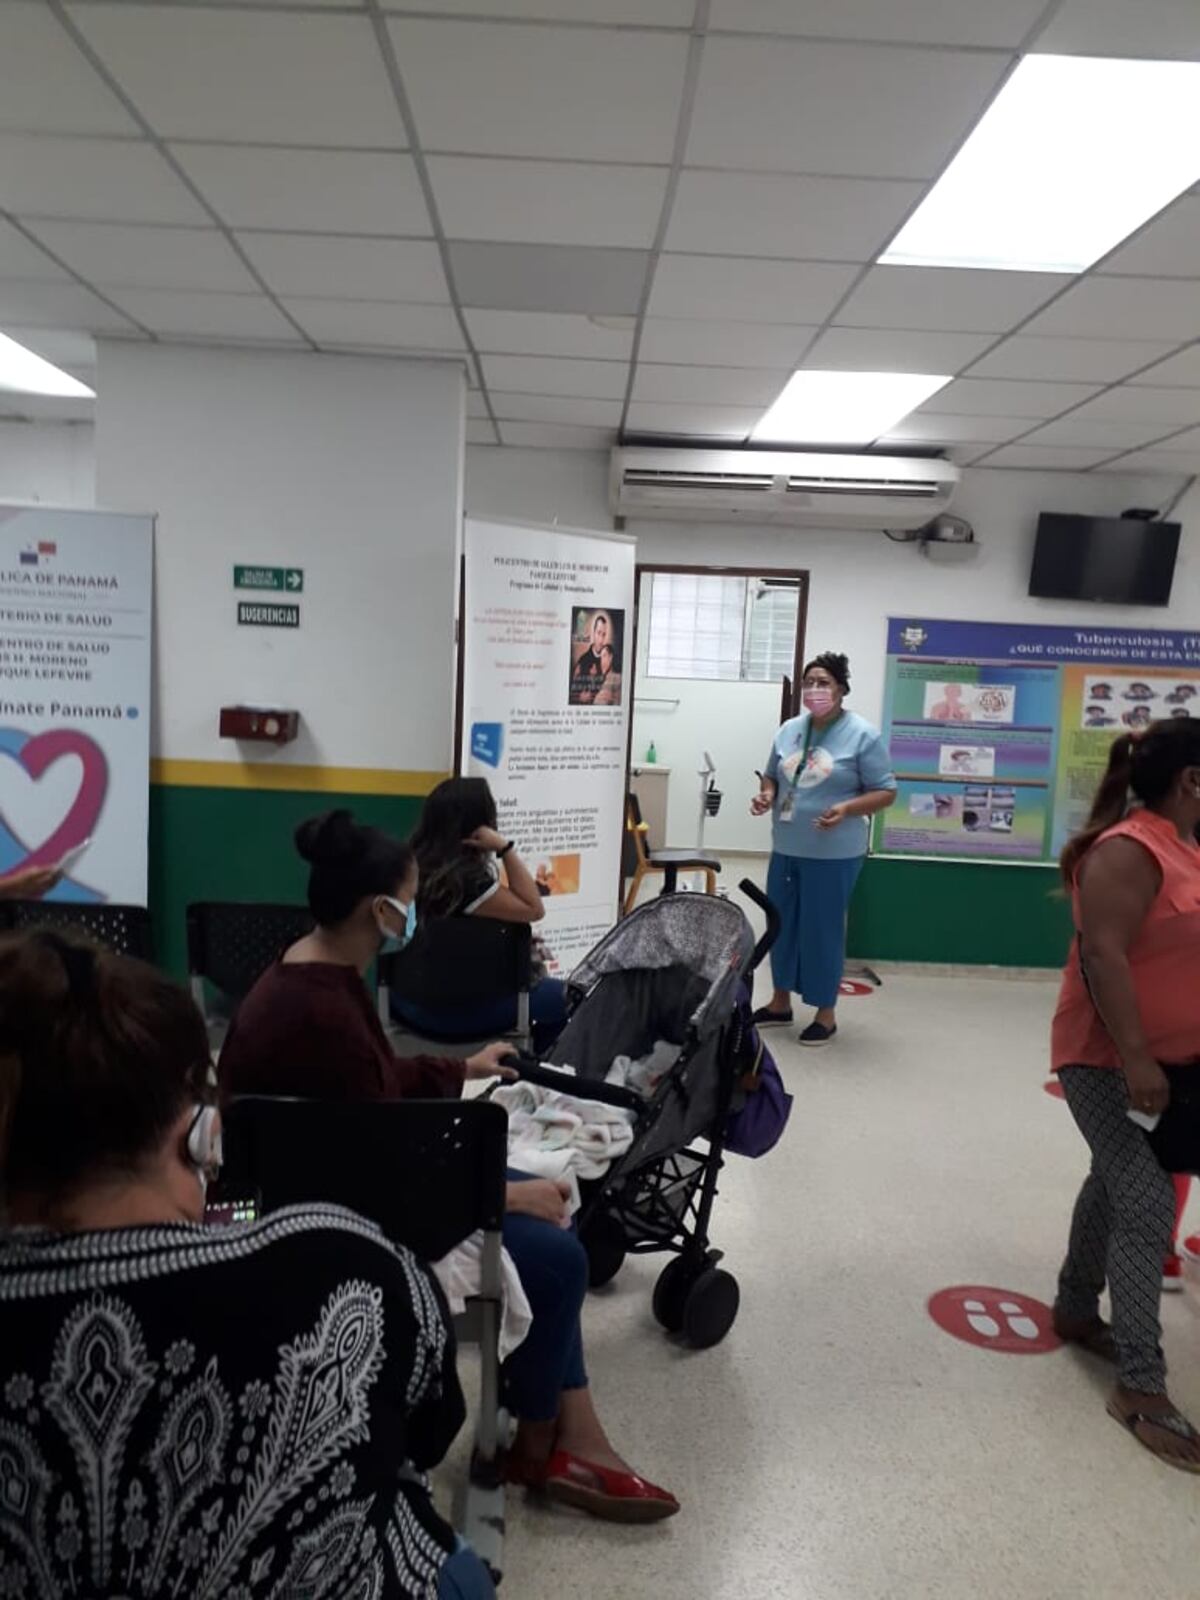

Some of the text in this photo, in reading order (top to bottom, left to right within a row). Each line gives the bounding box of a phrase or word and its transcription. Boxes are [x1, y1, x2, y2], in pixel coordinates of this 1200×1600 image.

[35, 573, 53, 585] DE
[44, 612, 61, 624] DE
[66, 612, 113, 627] SALUD
[1075, 632, 1174, 648] Tuberculosis
[46, 641, 62, 652] DE
[67, 641, 110, 655] SALUD
[1047, 645, 1129, 659] CONOCEMOS
[1131, 648, 1148, 659] DE
[29, 653, 88, 667] MORENO
[34, 668, 92, 681] LEFEVRE
[51, 702, 122, 720] Panamá
